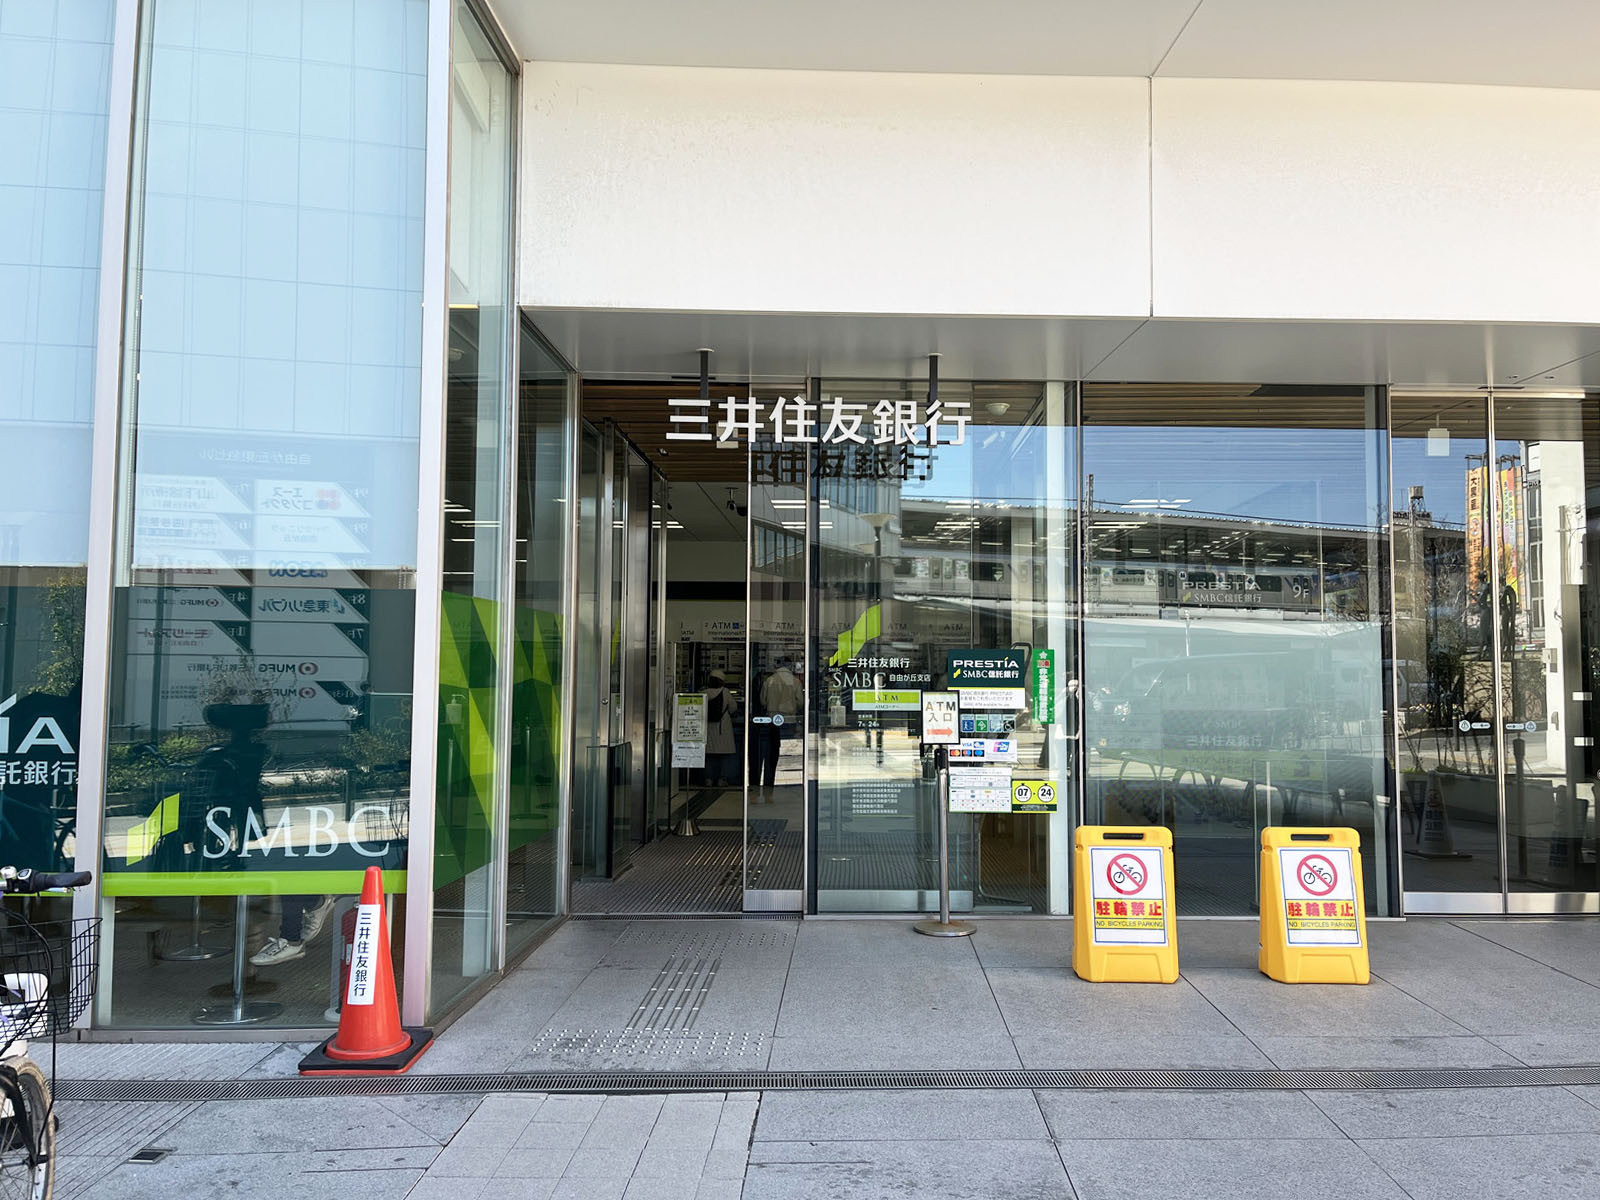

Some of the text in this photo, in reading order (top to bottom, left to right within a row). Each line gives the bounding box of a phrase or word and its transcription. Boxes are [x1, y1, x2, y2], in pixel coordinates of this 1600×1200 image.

[666, 396, 972, 446] 三井住友銀行
[1293, 585, 1309, 599] 9F
[847, 657, 911, 668] 三井住友銀行
[832, 672, 887, 688] SMBC
[889, 673, 932, 682] 自由が丘支店
[963, 670, 1019, 679] SMBC信託銀行
[925, 701, 956, 711] ATM
[928, 713, 952, 722] 入口
[1017, 788, 1052, 797] 07 24
[203, 806, 390, 858] SMBC
[1096, 901, 1162, 916] 駐輪禁止
[1288, 902, 1355, 917] 駐輪禁止
[354, 912, 372, 997] 三井住友銀行
